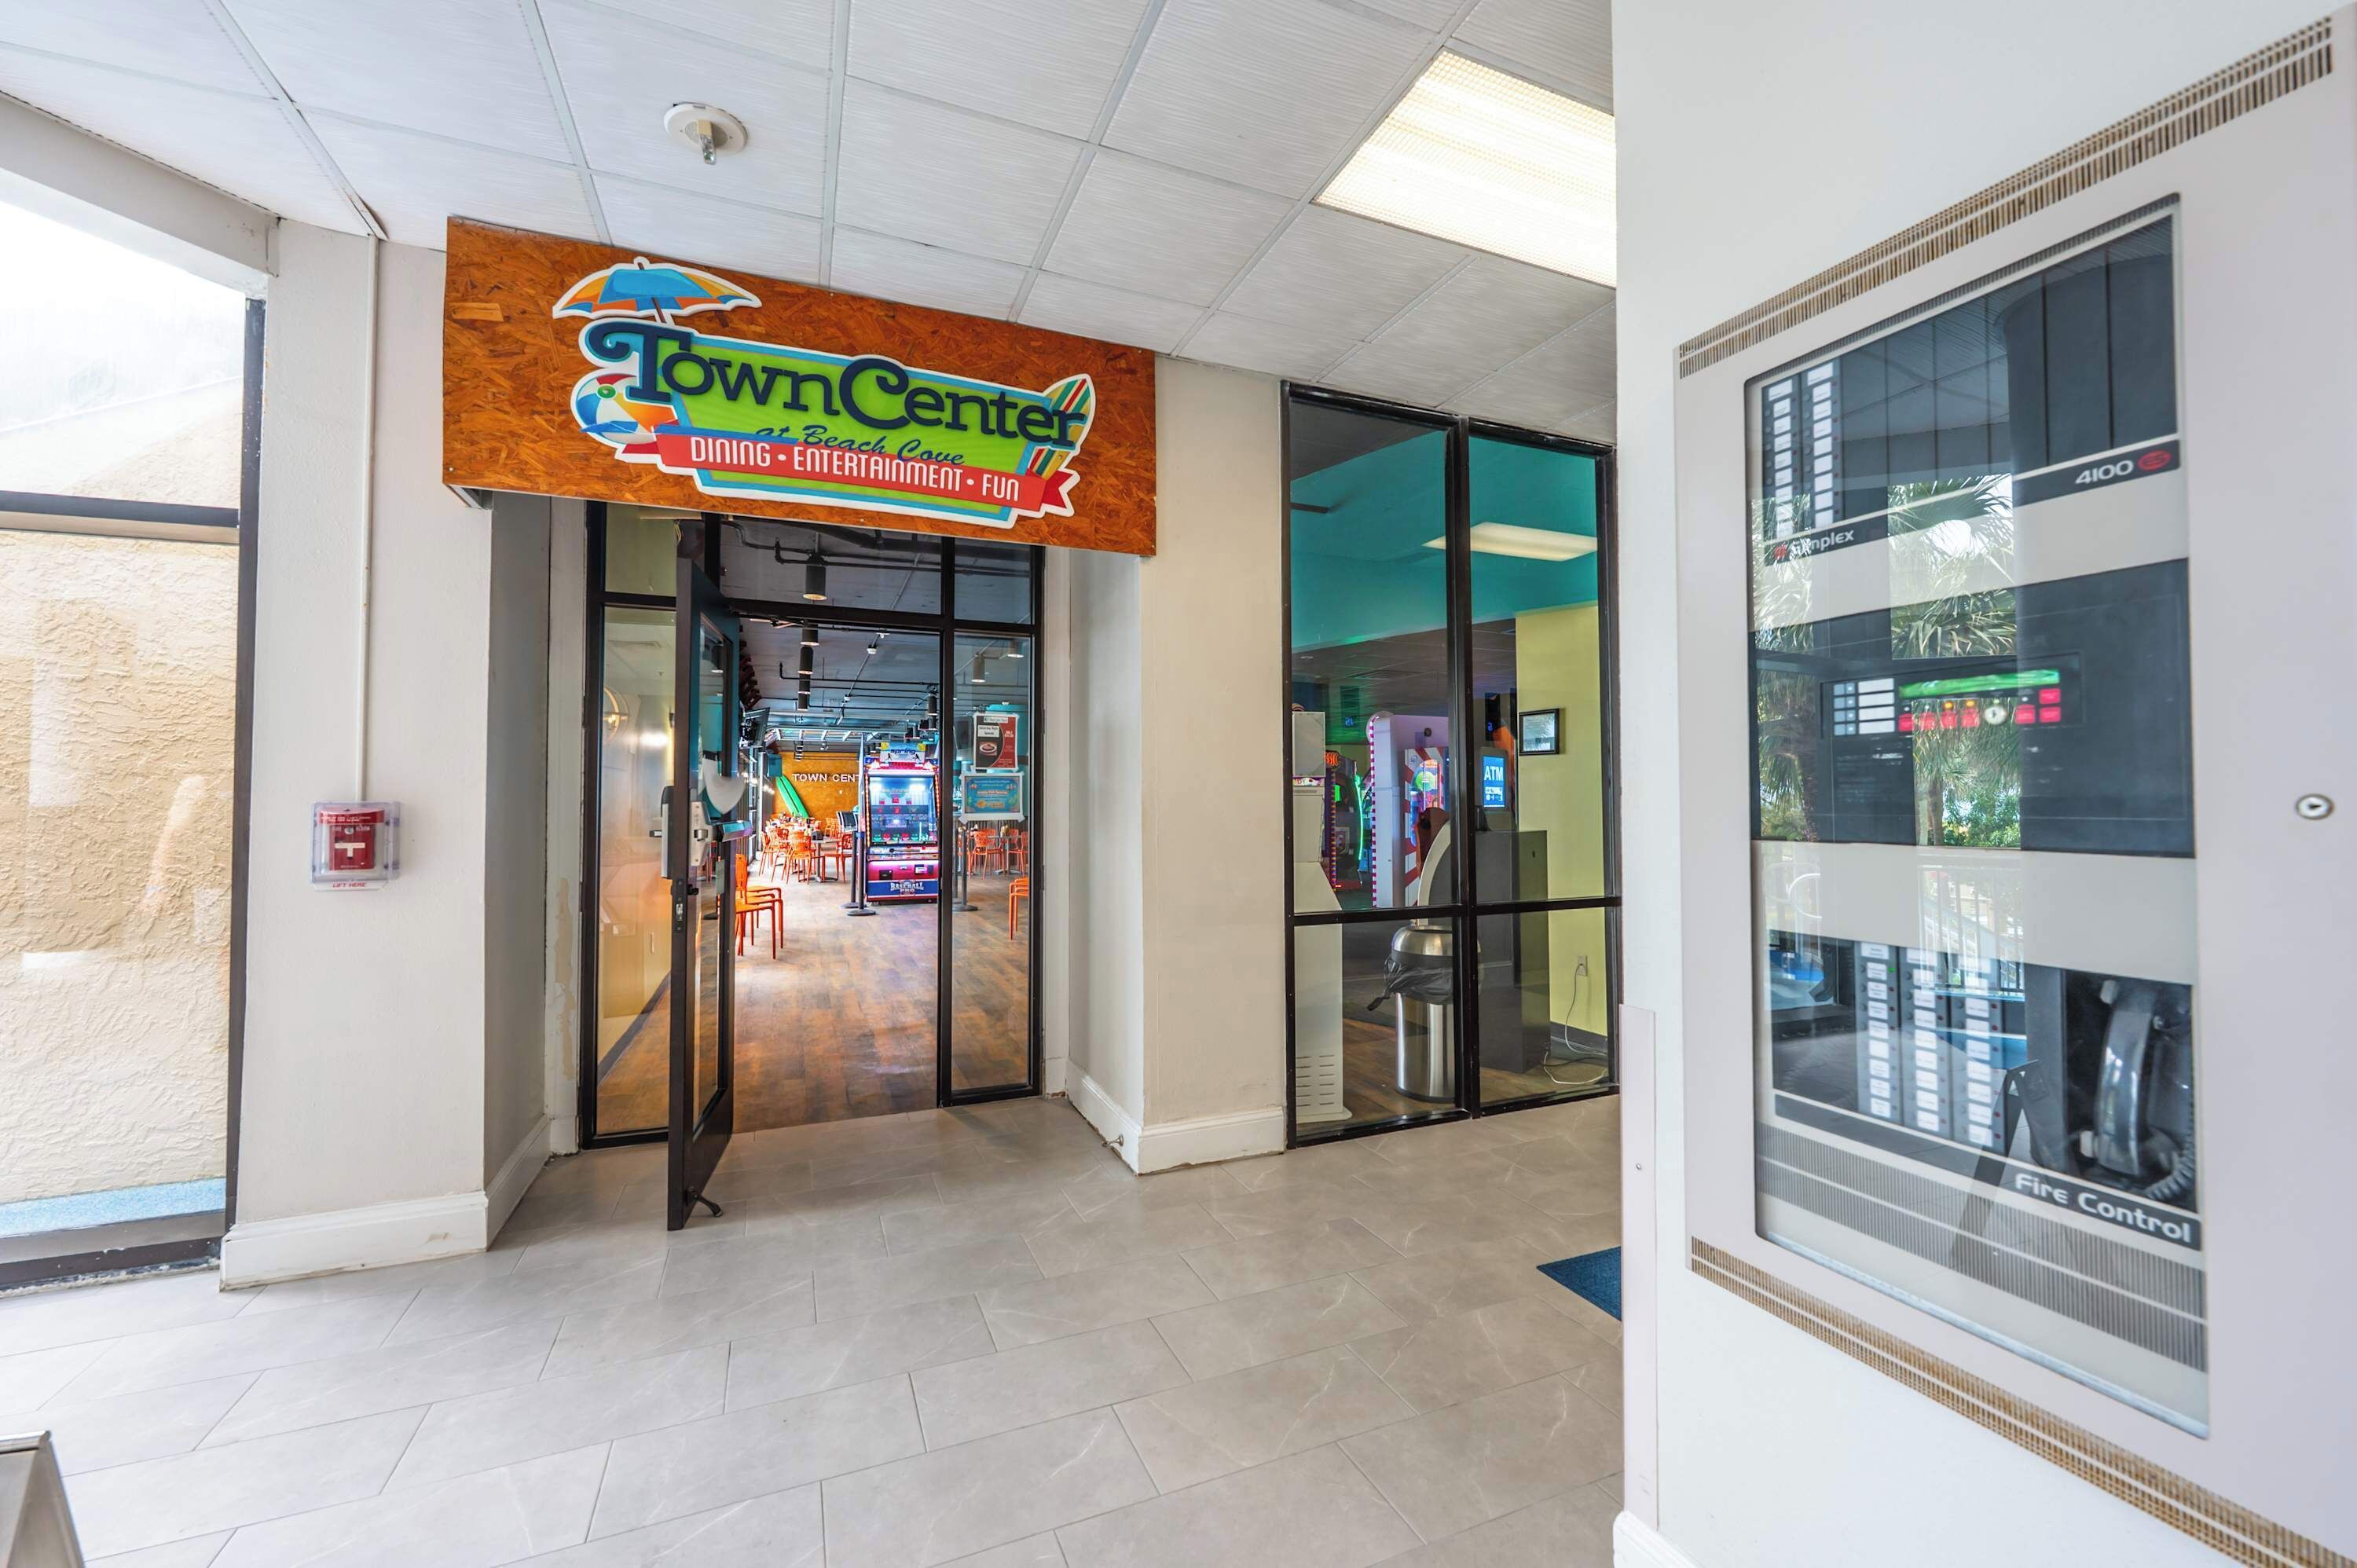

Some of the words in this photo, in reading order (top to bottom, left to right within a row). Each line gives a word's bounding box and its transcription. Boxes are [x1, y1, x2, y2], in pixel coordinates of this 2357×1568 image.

[801, 424, 887, 455] Beach
[897, 438, 966, 466] Cove
[691, 436, 772, 467] DINING
[793, 445, 963, 492] ENTERTAINMENT
[981, 473, 1020, 502] FUN
[2075, 460, 2134, 485] 4100
[792, 773, 828, 783] TOWN
[1483, 765, 1504, 781] ATM
[890, 881, 925, 892] BASEBALL
[2014, 1172, 2069, 1205] Fire
[2077, 1192, 2191, 1244] Control
